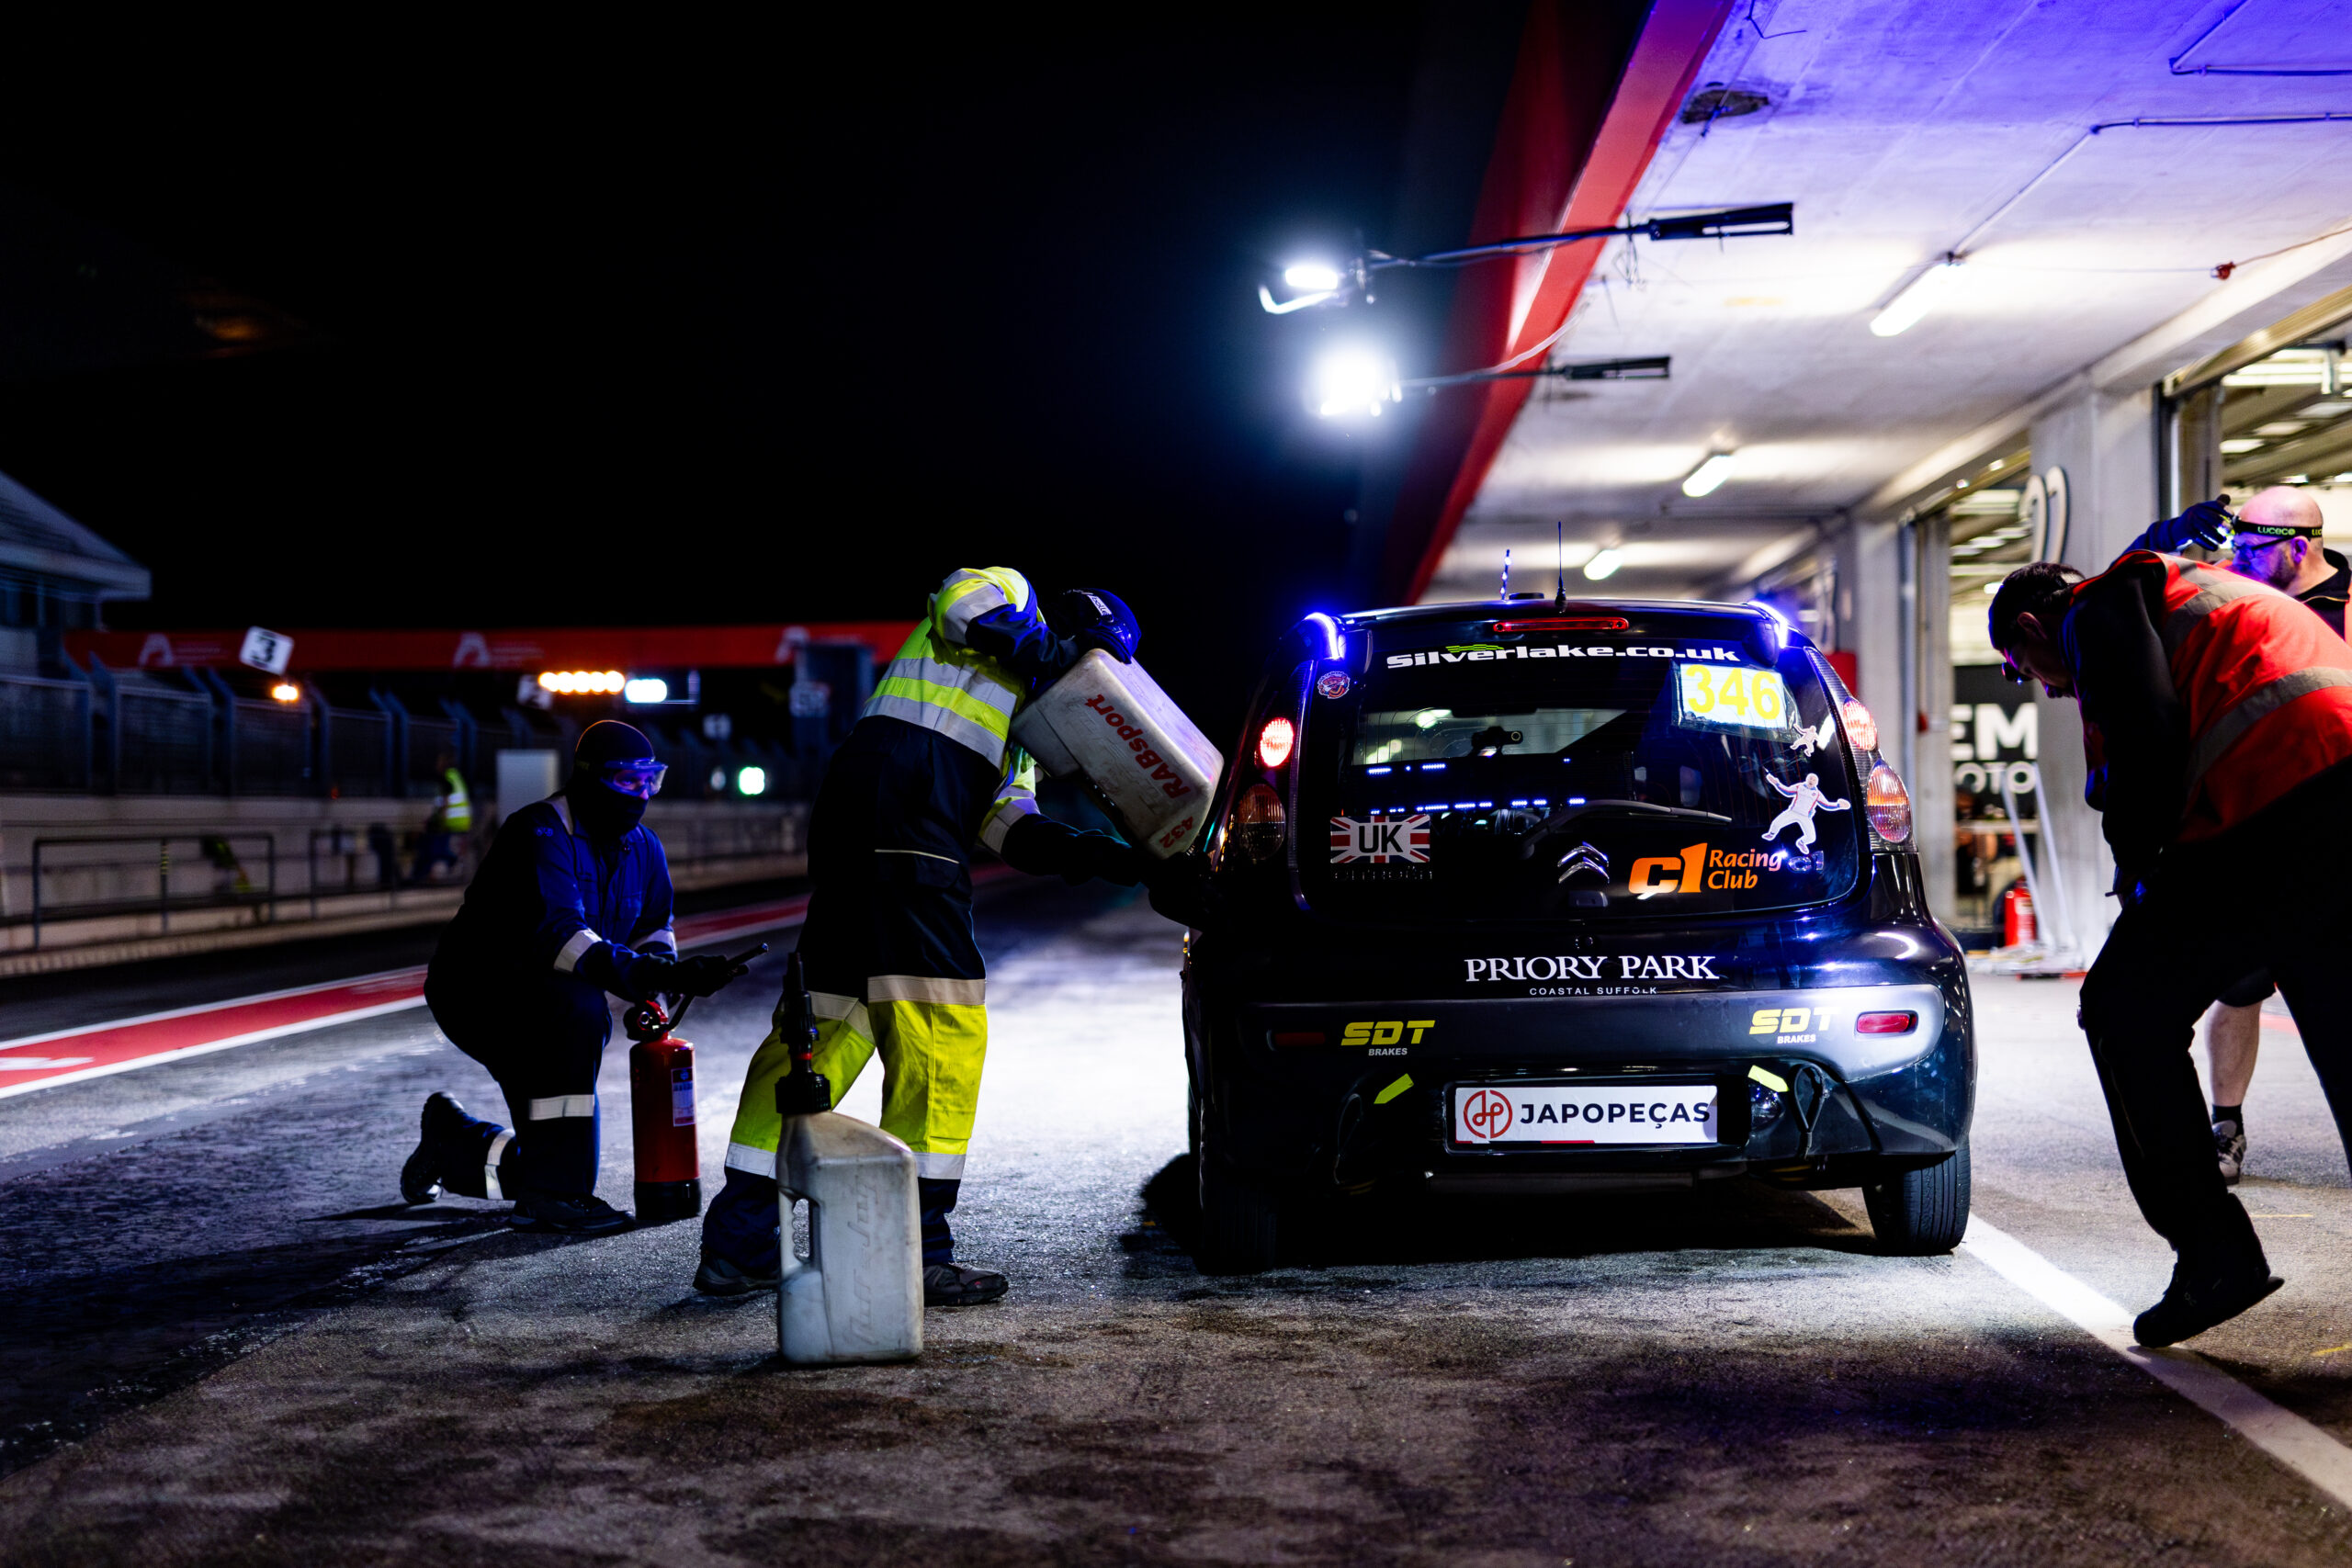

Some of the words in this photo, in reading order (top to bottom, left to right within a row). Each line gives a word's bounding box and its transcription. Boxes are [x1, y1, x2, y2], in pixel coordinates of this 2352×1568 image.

[1386, 645, 1741, 669] Silverlake.co.uk
[1686, 663, 1781, 720] 346
[1359, 825, 1404, 852] UK
[1709, 848, 1783, 872] Racing
[1708, 870, 1759, 890] Club
[1464, 956, 1608, 982] PRIORY
[1618, 955, 1720, 980] PARK
[1529, 987, 1590, 996] COASTAL
[1340, 1020, 1435, 1046] SDT
[1777, 1033, 1816, 1043] BRAKES
[1368, 1047, 1408, 1056] BRAKES
[1520, 1100, 1711, 1130] JAPOPEÇAS
